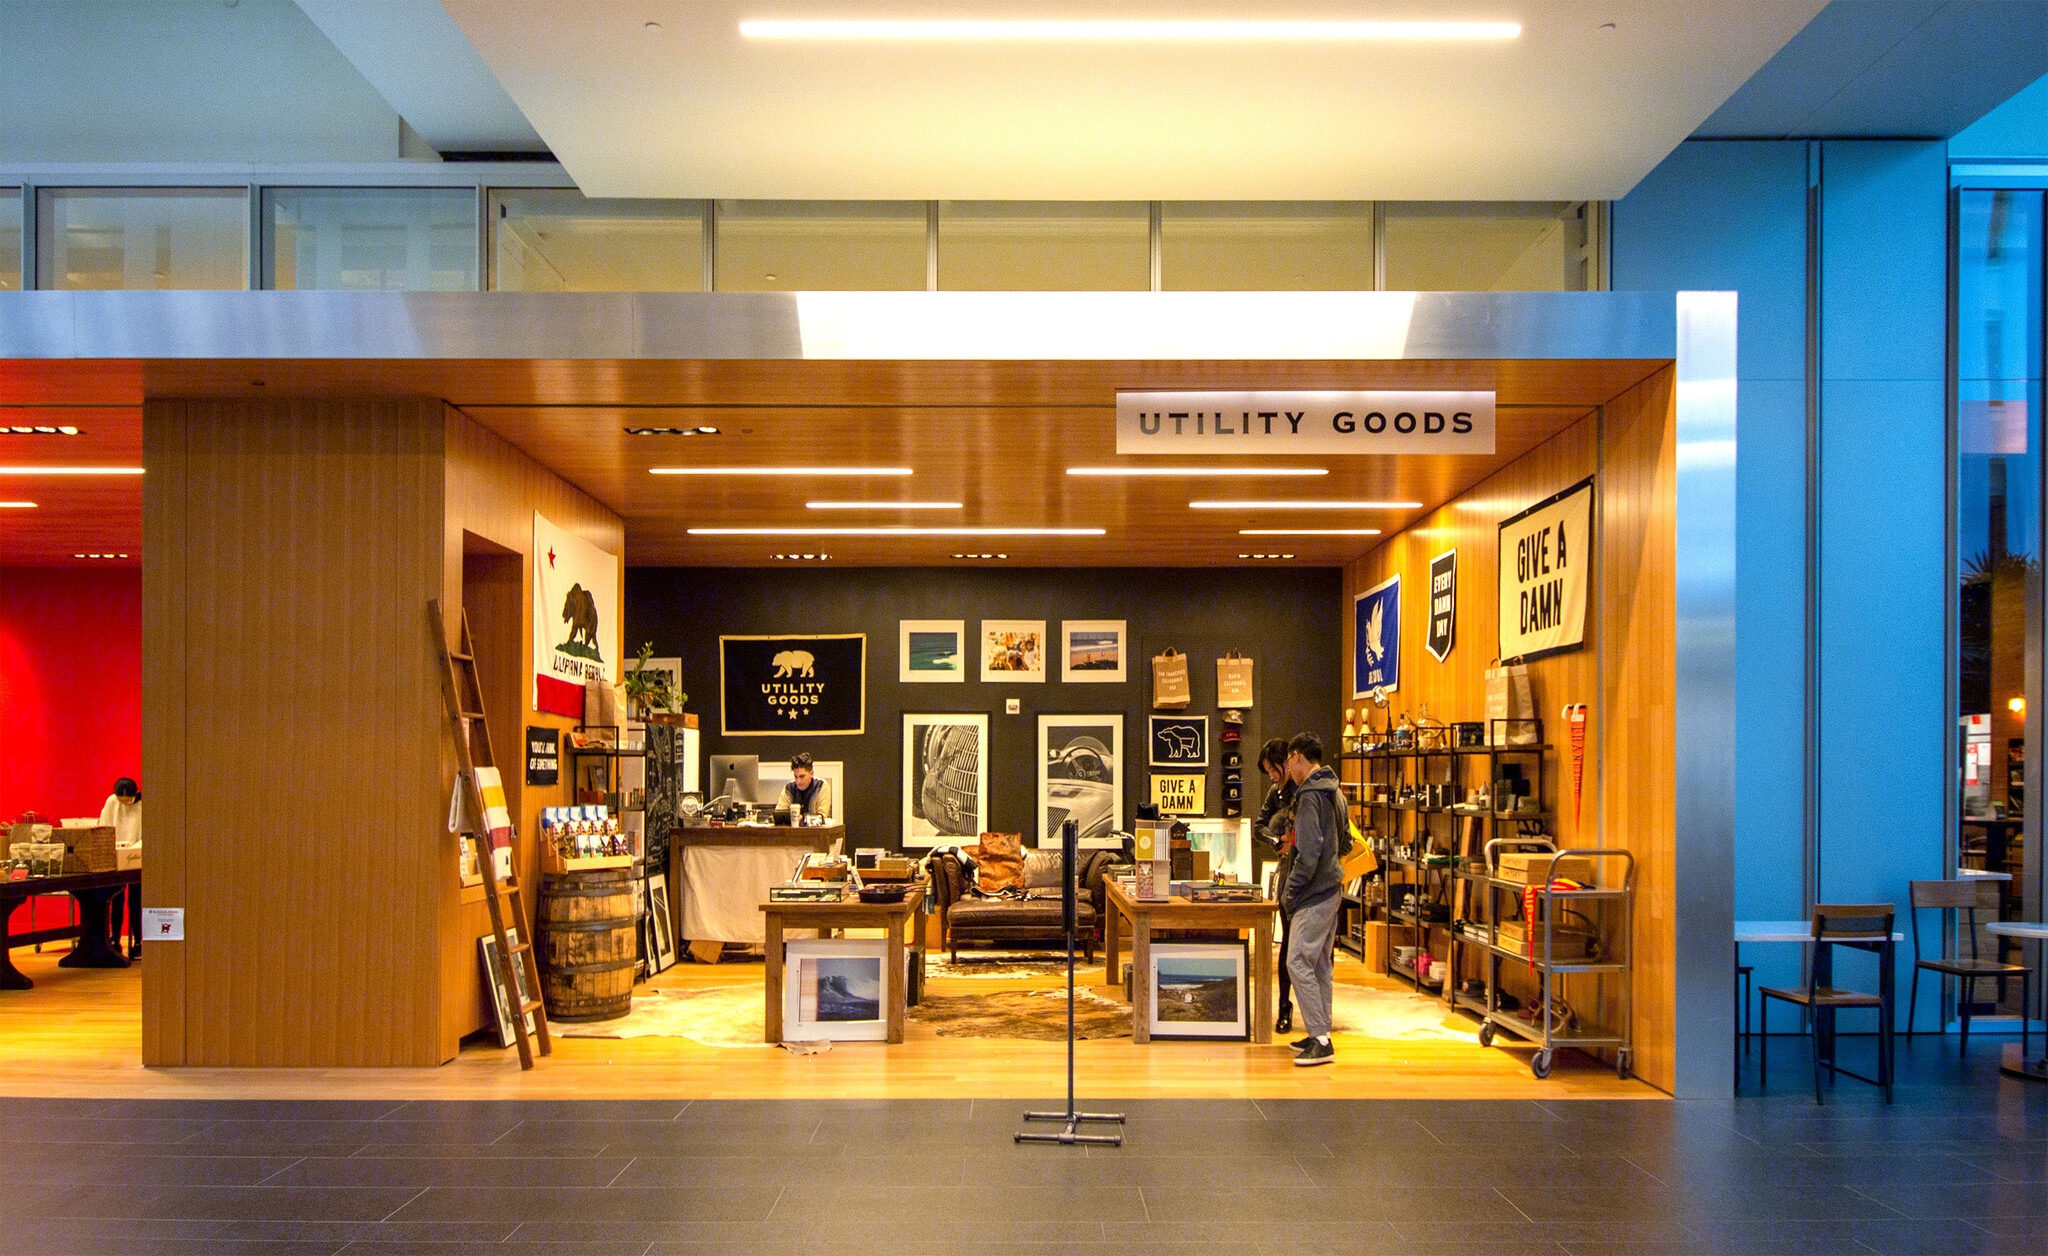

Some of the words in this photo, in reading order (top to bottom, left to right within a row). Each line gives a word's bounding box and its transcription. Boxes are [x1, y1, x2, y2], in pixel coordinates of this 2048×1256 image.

[1139, 411, 1305, 435] UTILITY
[1332, 411, 1473, 435] GOODS
[1517, 526, 1551, 584] GIVE
[1556, 520, 1567, 570] A
[1433, 570, 1452, 594] EVERY
[1434, 594, 1451, 616] DAMN
[1520, 578, 1563, 636] DAMN
[1436, 618, 1448, 638] DAY
[761, 683, 825, 694] UTILITY
[767, 695, 819, 705] GOODS
[1160, 779, 1184, 793] GIVE
[1189, 779, 1195, 793] A
[1162, 795, 1193, 809] DAMN
